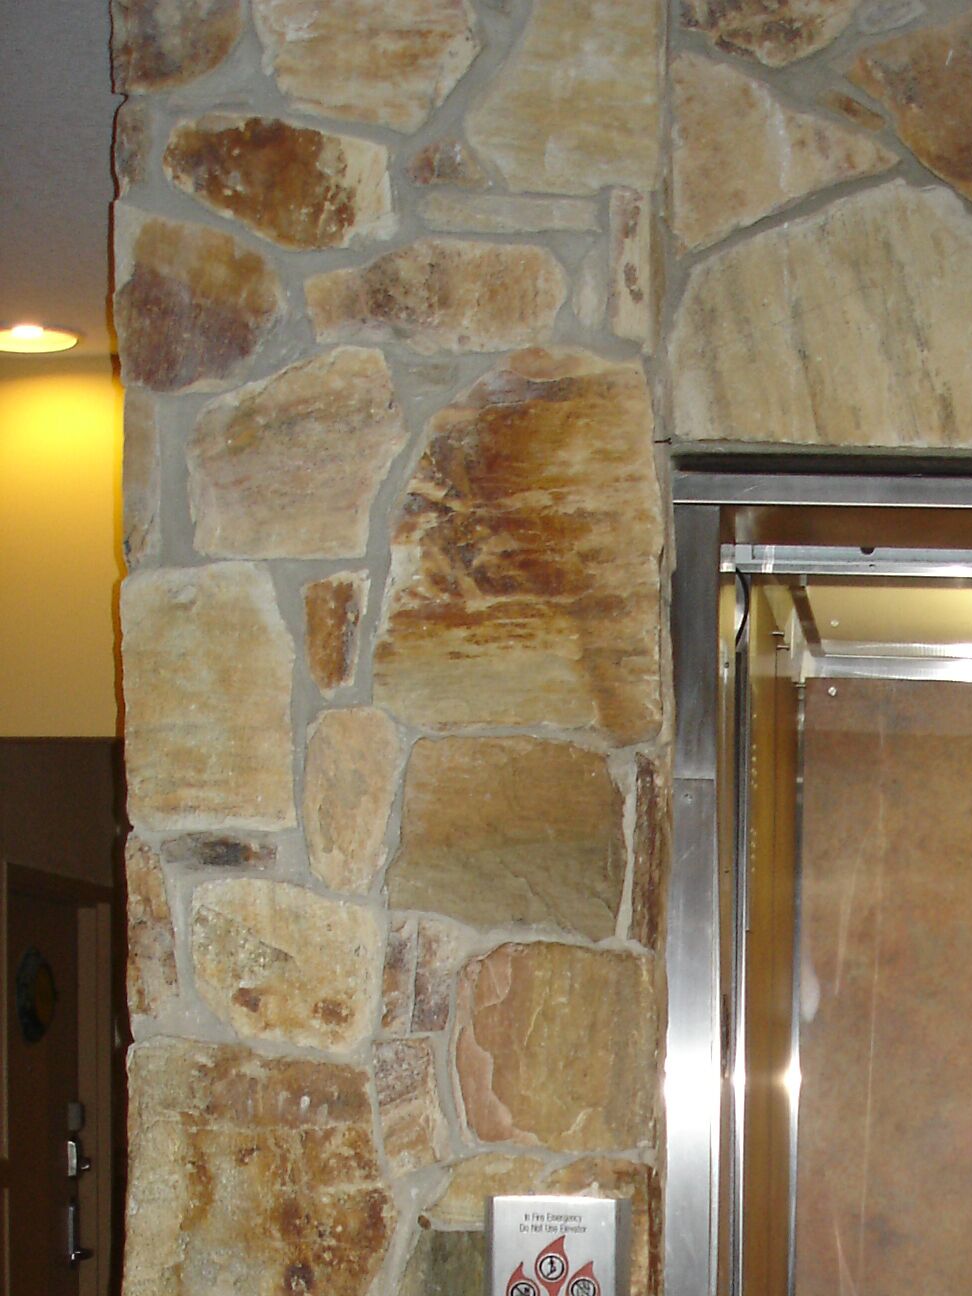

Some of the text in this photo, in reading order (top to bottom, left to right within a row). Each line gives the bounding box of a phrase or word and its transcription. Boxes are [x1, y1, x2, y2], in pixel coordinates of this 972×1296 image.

[546, 1213, 582, 1223] Emergency
[519, 1224, 587, 1233] Do Not Use Elevator
